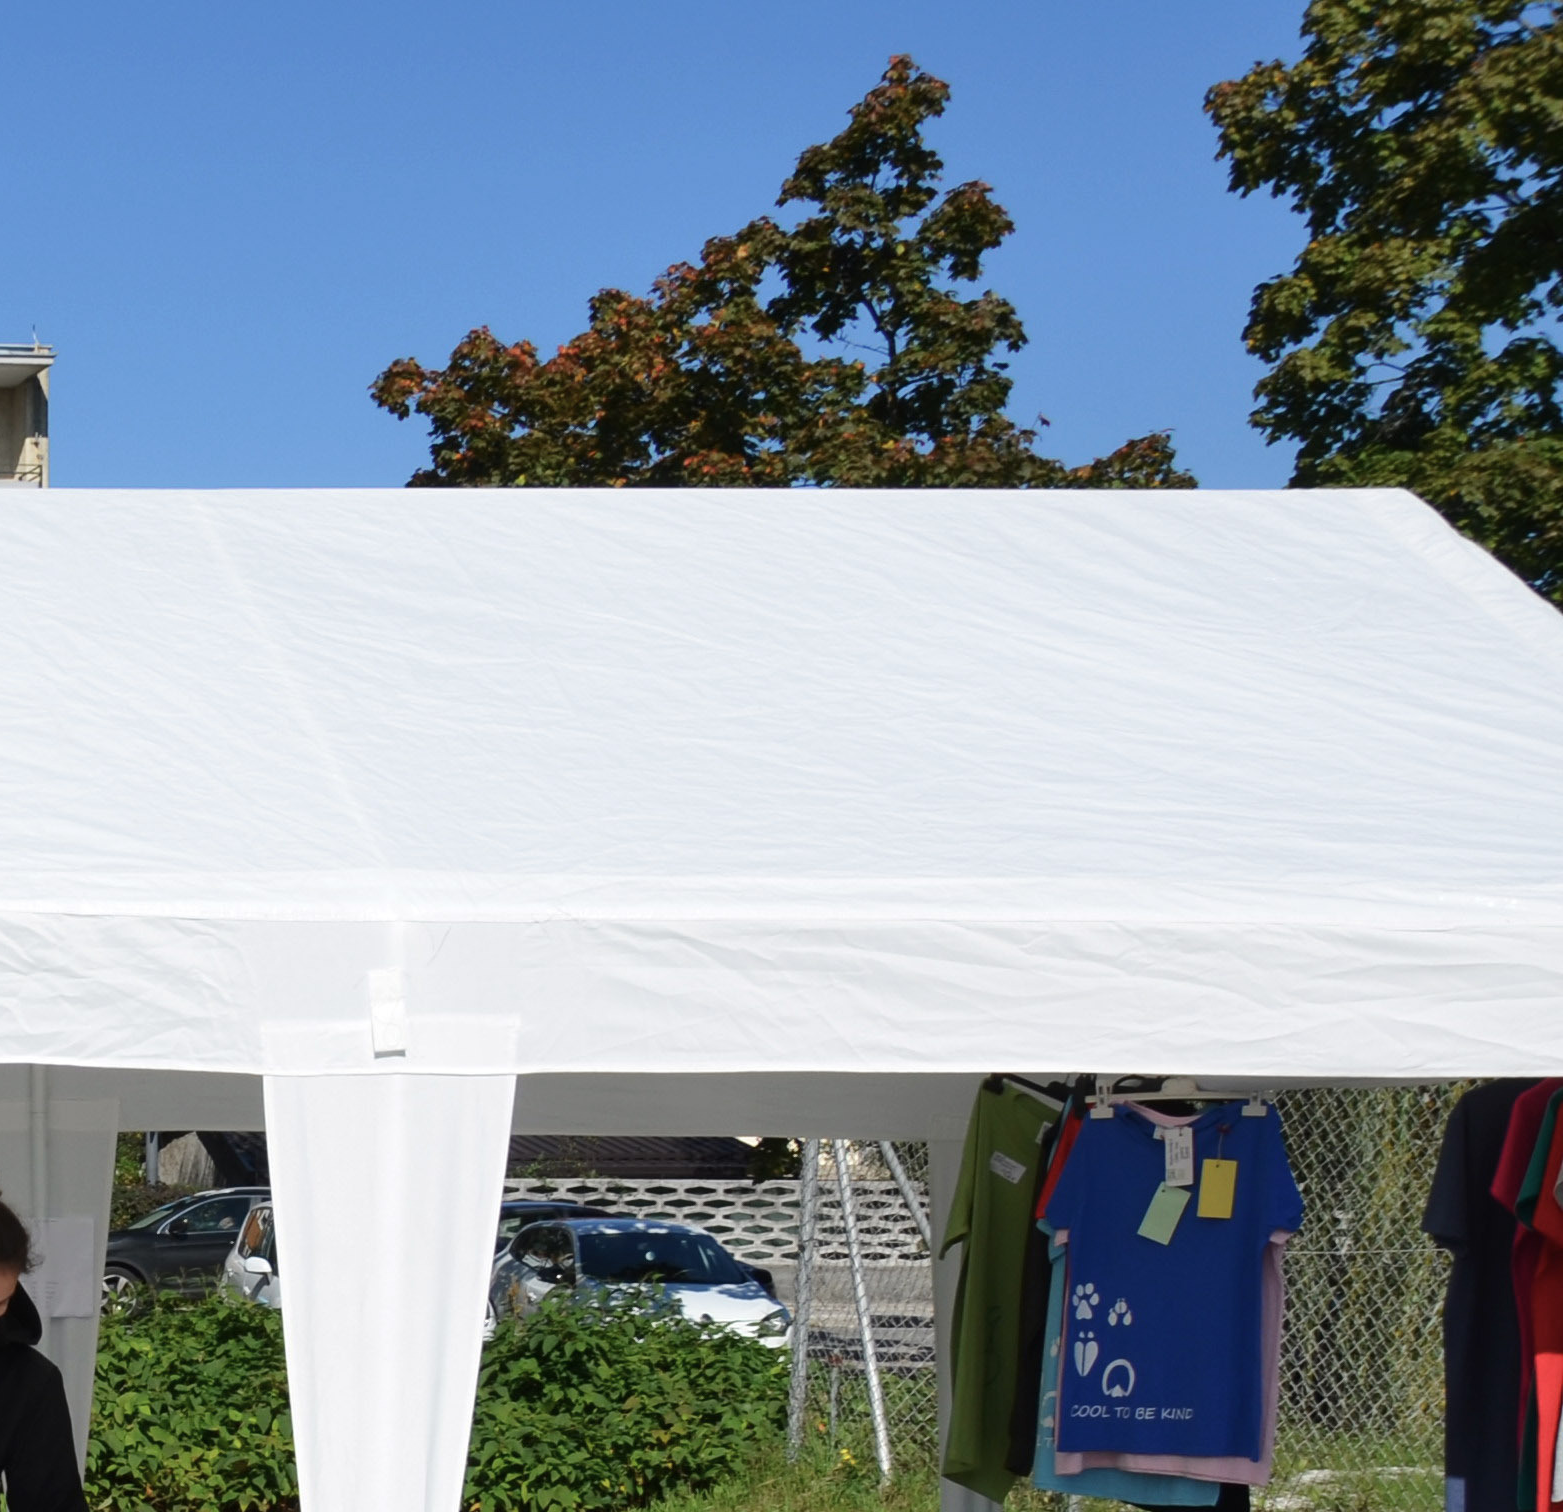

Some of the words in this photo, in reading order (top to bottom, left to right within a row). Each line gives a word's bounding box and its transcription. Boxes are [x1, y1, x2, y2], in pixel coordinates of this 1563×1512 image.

[1070, 1404, 1110, 1418] COOL
[1114, 1406, 1131, 1419] TO
[1135, 1407, 1156, 1420] BE
[1161, 1407, 1194, 1420] KIND
